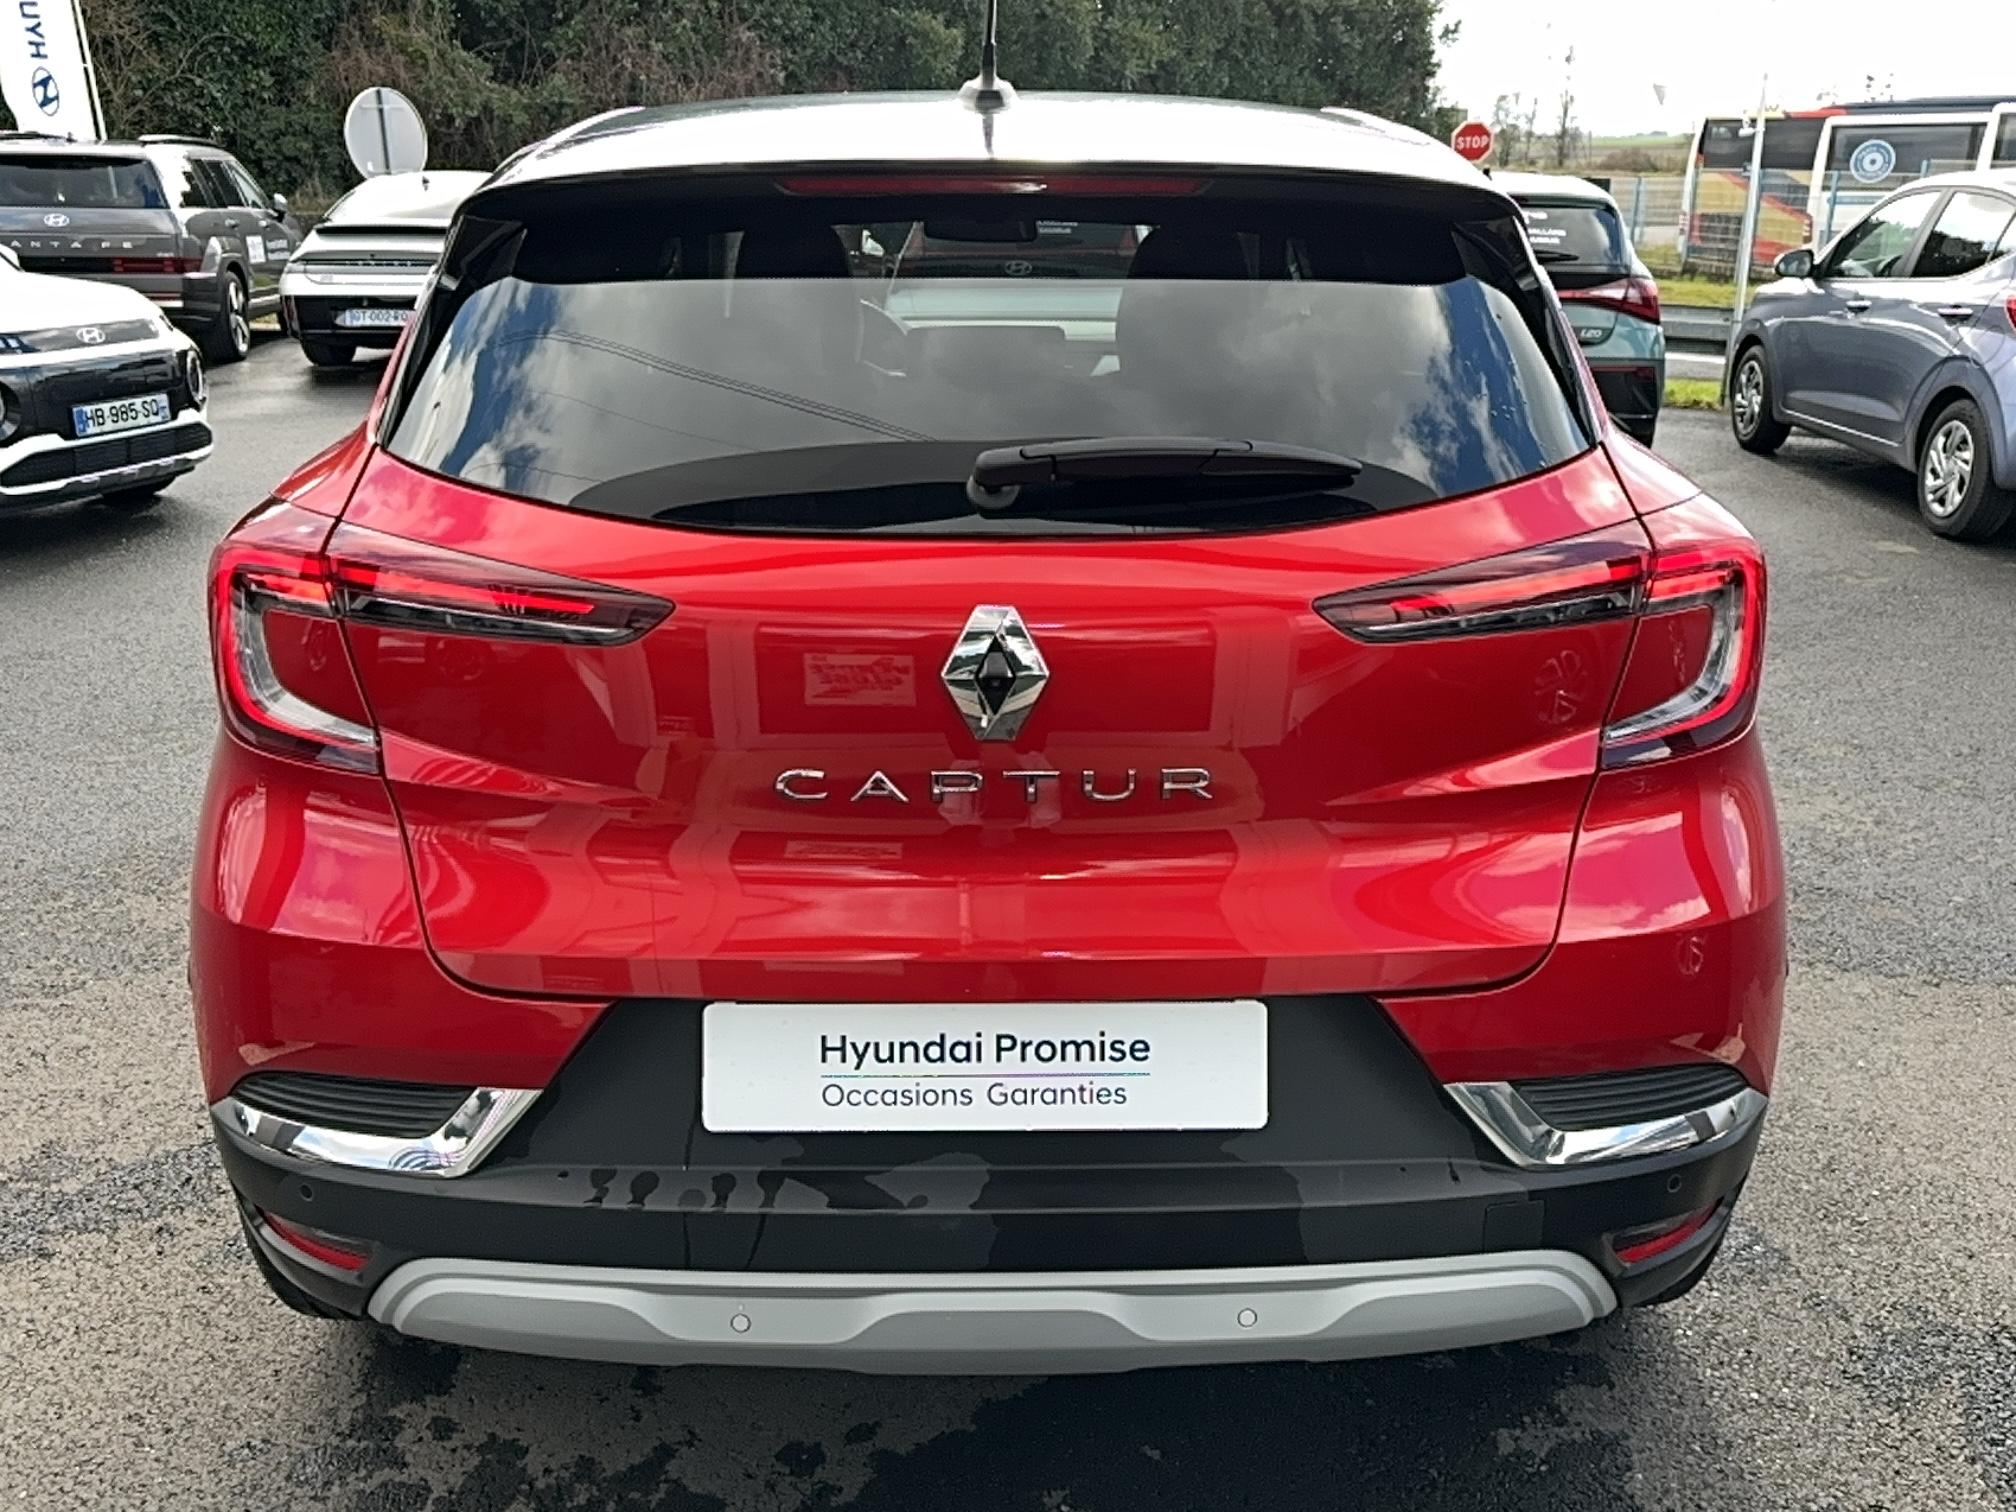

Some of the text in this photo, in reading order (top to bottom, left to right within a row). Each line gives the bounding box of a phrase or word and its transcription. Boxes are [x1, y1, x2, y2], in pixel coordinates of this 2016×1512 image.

[1456, 134, 1489, 150] STOP
[101, 241, 133, 249] FE
[774, 767, 1214, 802] CAPTUR
[819, 1031, 1151, 1071] Hyundai Promise
[821, 1080, 1128, 1108] Occasions Garanties
